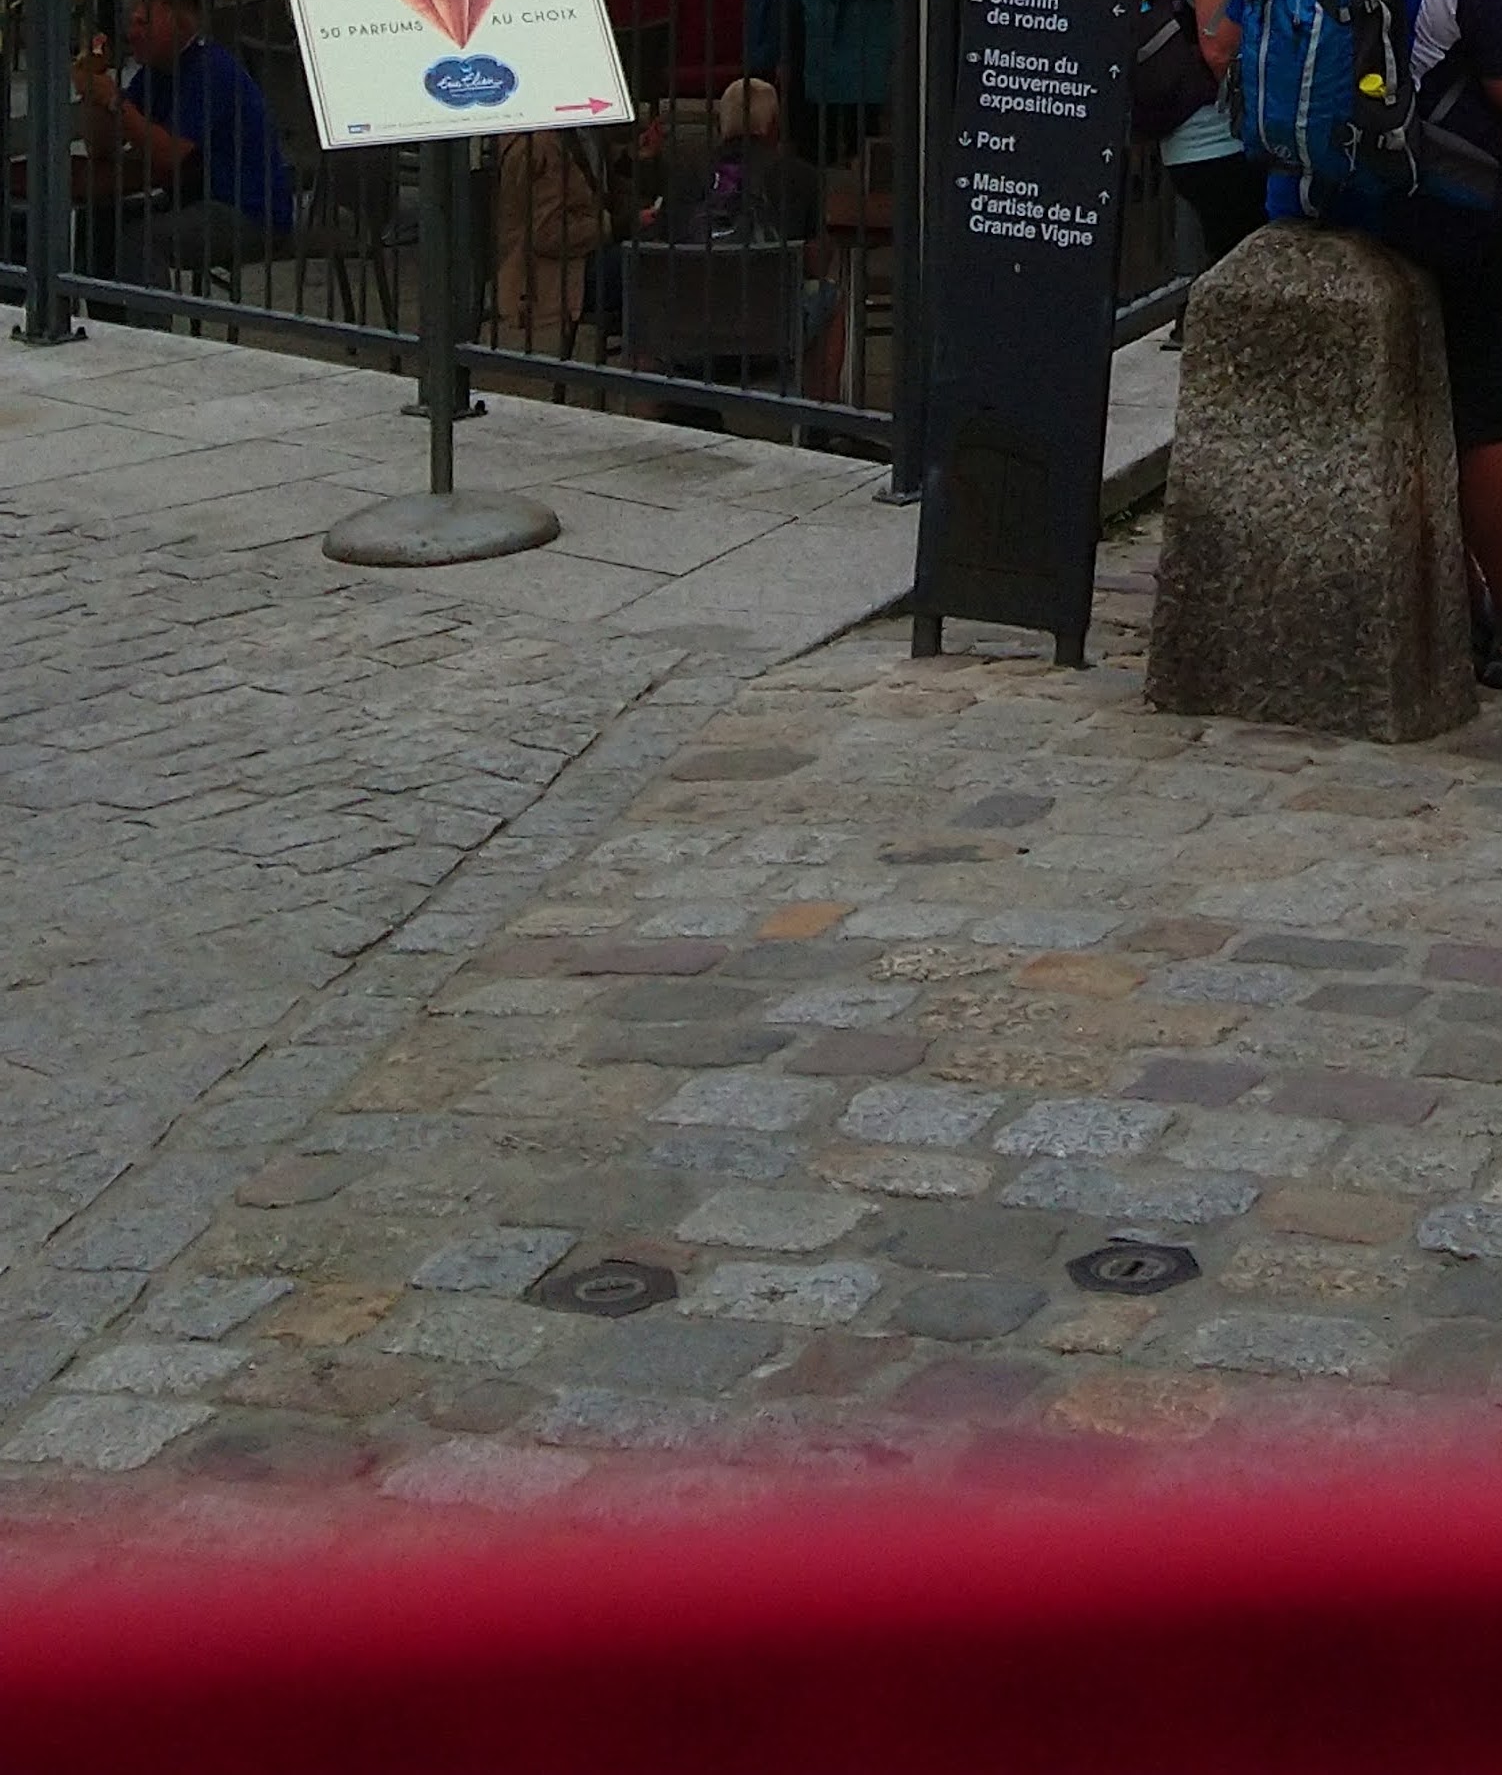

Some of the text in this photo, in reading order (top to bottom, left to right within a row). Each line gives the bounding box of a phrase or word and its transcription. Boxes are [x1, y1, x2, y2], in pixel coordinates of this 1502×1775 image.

[320, 8, 578, 40] 50 PARFUMS AU CHOIX
[986, 8, 1069, 33] de ronde
[983, 48, 1079, 76] Maison du
[981, 70, 1099, 97] Gouverneur-
[979, 93, 1088, 119] expositions
[976, 130, 1017, 152] Port
[973, 173, 1039, 197] Maison
[970, 194, 1099, 226] d'artiste de La
[969, 215, 1094, 248] Grande Vigne
